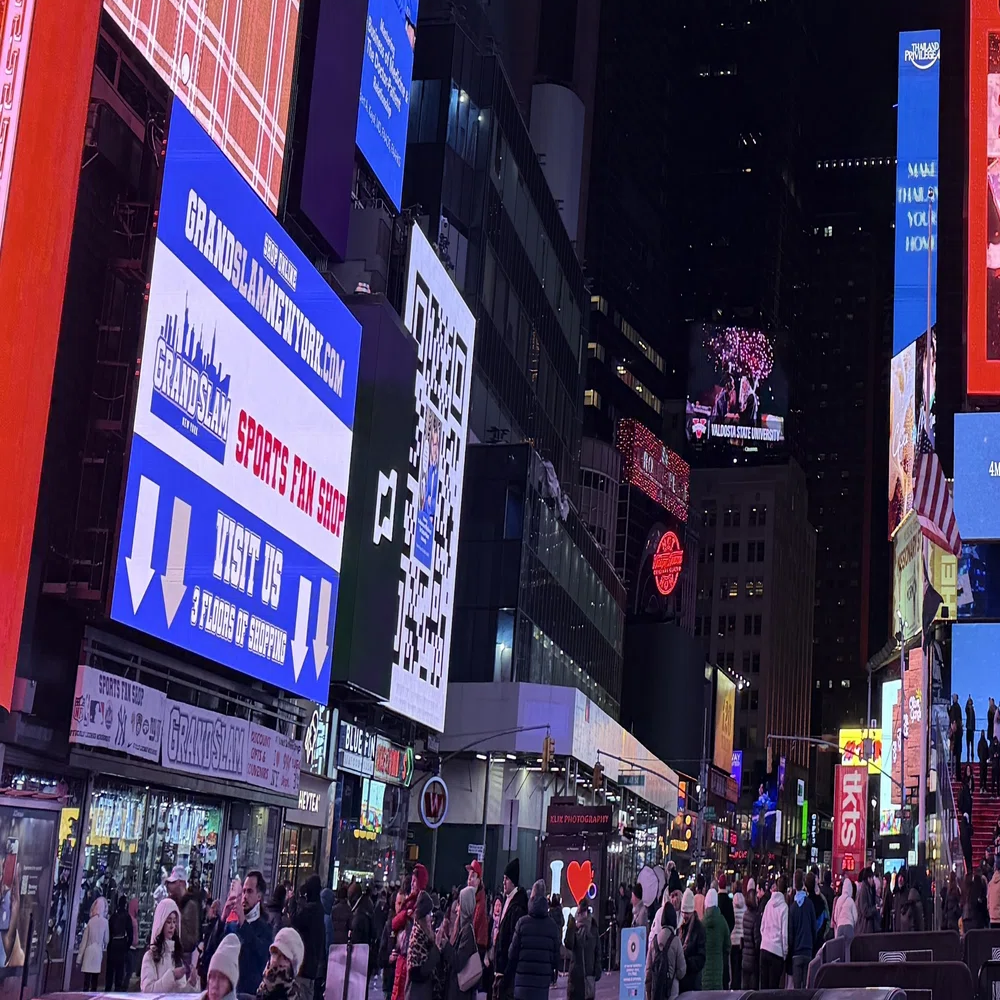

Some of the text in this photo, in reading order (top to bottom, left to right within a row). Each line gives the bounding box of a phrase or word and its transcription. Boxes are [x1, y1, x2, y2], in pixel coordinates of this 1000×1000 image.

[711, 423, 737, 438] VALDOSTA
[736, 425, 752, 440] STATE
[235, 408, 346, 538] SPORTS FAN SHOP
[213, 509, 284, 610] VISIT US
[190, 584, 288, 666] 3 FLOORS OF SHOPPING
[98, 674, 121, 699] SPORTS
[345, 724, 363, 752] BLUE
[298, 790, 321, 813] HEYTEA
[841, 773, 861, 847] tkts
[563, 815, 609, 824] PHOTOGRAPHY
